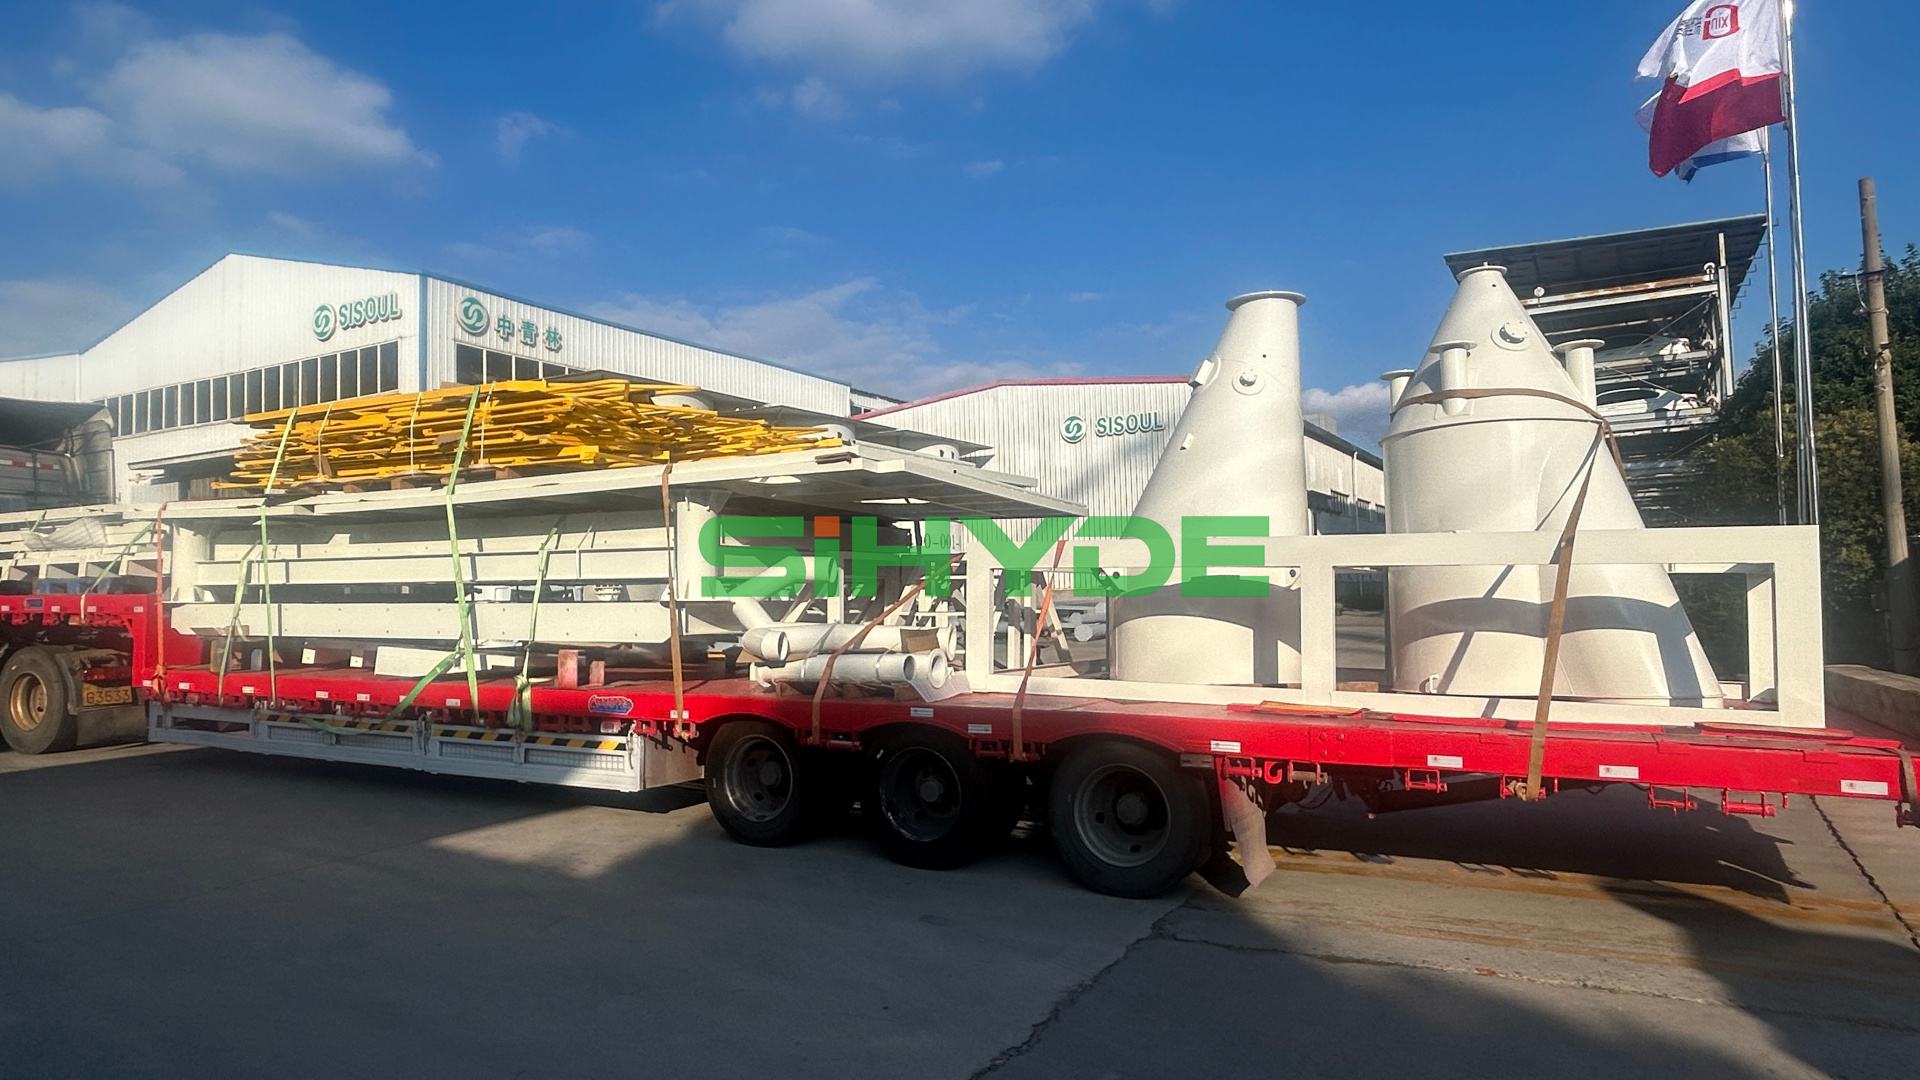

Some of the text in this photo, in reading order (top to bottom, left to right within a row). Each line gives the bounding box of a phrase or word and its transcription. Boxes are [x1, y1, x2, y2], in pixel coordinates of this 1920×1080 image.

[338, 293, 400, 328] SISOUL
[496, 314, 562, 349] 中青林
[1096, 411, 1164, 436] SISOUL
